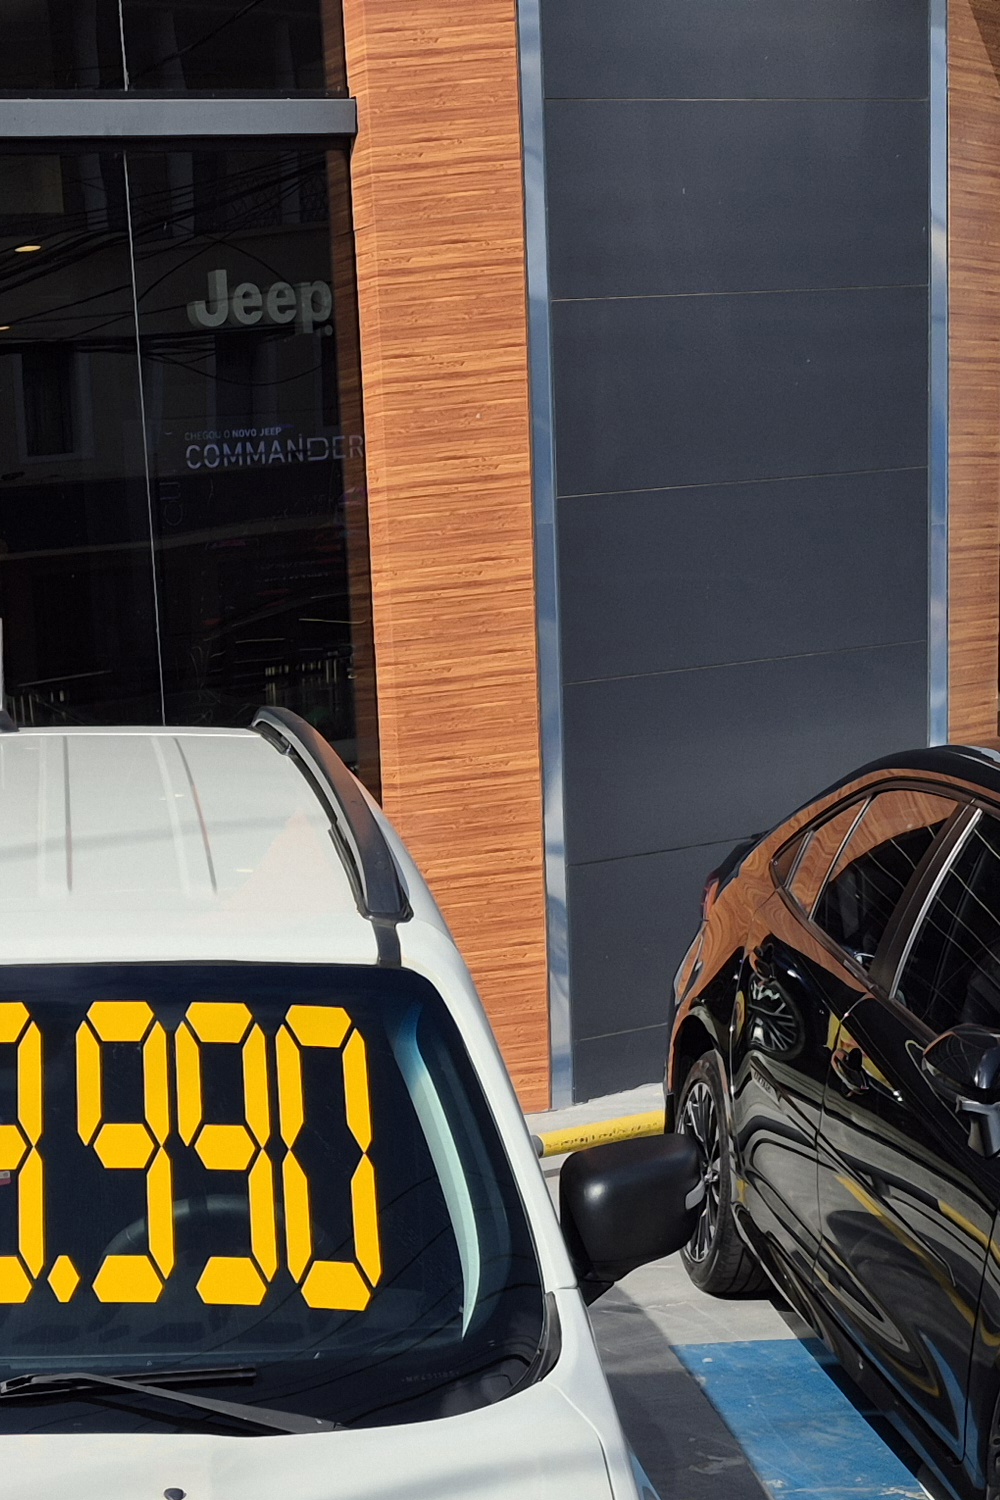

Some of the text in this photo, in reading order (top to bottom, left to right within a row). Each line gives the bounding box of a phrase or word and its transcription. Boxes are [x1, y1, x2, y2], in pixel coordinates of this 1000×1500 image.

[187, 269, 333, 334] Jeep
[232, 428, 257, 438] NOVO
[259, 426, 282, 437] JEEP
[185, 434, 364, 469] COMMANDER
